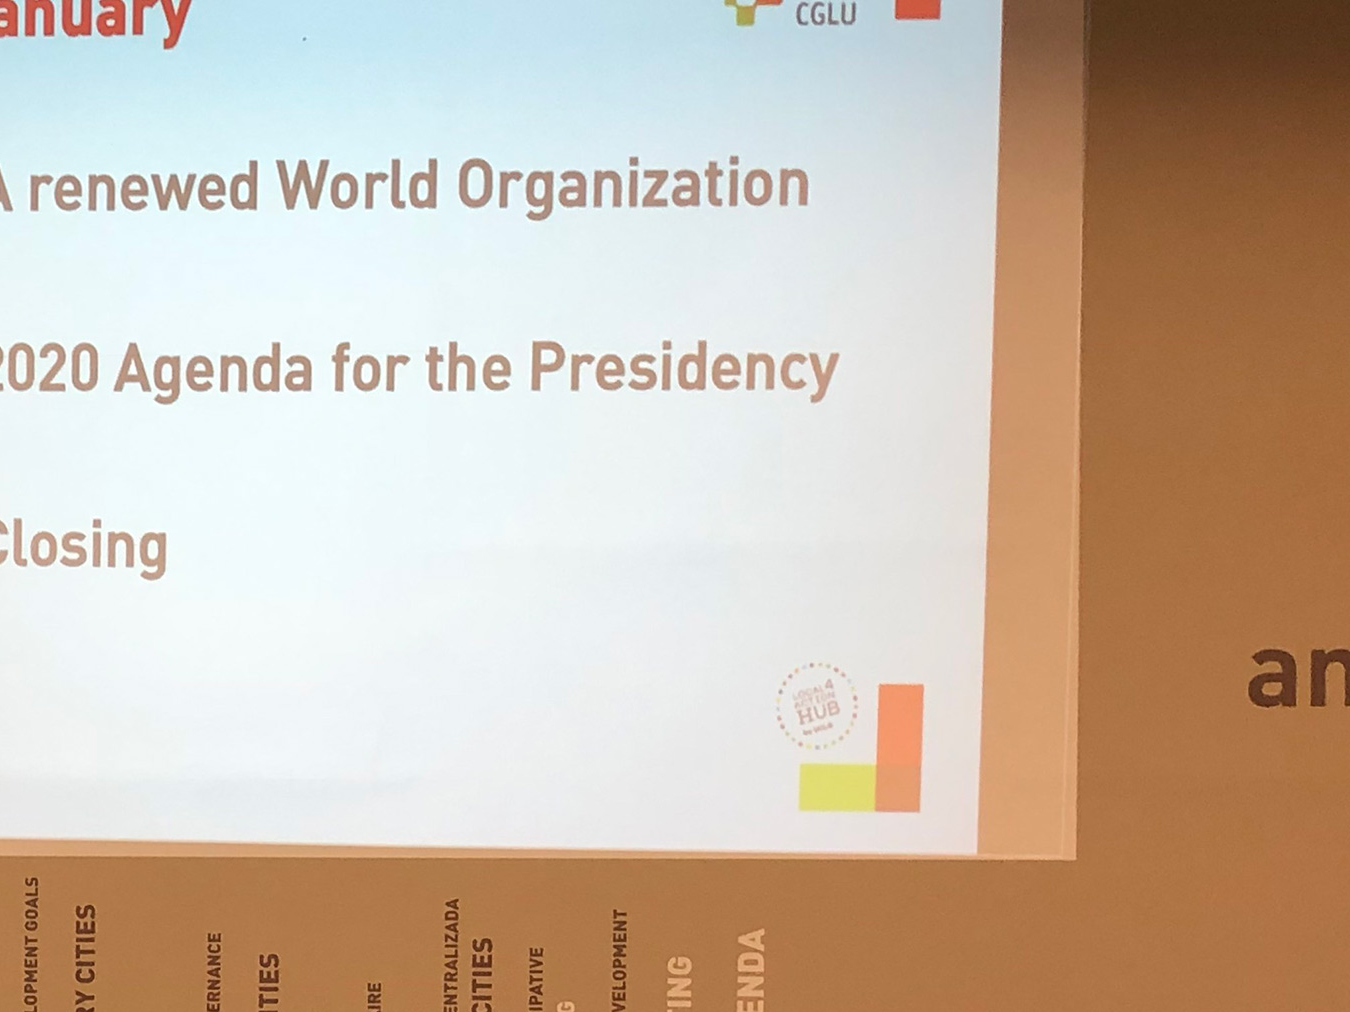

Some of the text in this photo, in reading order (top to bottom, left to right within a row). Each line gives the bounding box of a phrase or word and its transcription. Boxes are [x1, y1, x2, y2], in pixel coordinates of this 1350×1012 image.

[795, 1, 857, 26] CGLU
[29, 159, 259, 212] renewed
[275, 157, 438, 211] World
[458, 155, 809, 222] Organization
[113, 341, 313, 406] Agenda
[332, 341, 411, 393] for
[425, 341, 512, 392] the
[530, 340, 840, 404] Presidency
[796, 699, 841, 726] HUB
[25, 876, 40, 932] GOALS
[75, 904, 96, 984] CITIES
